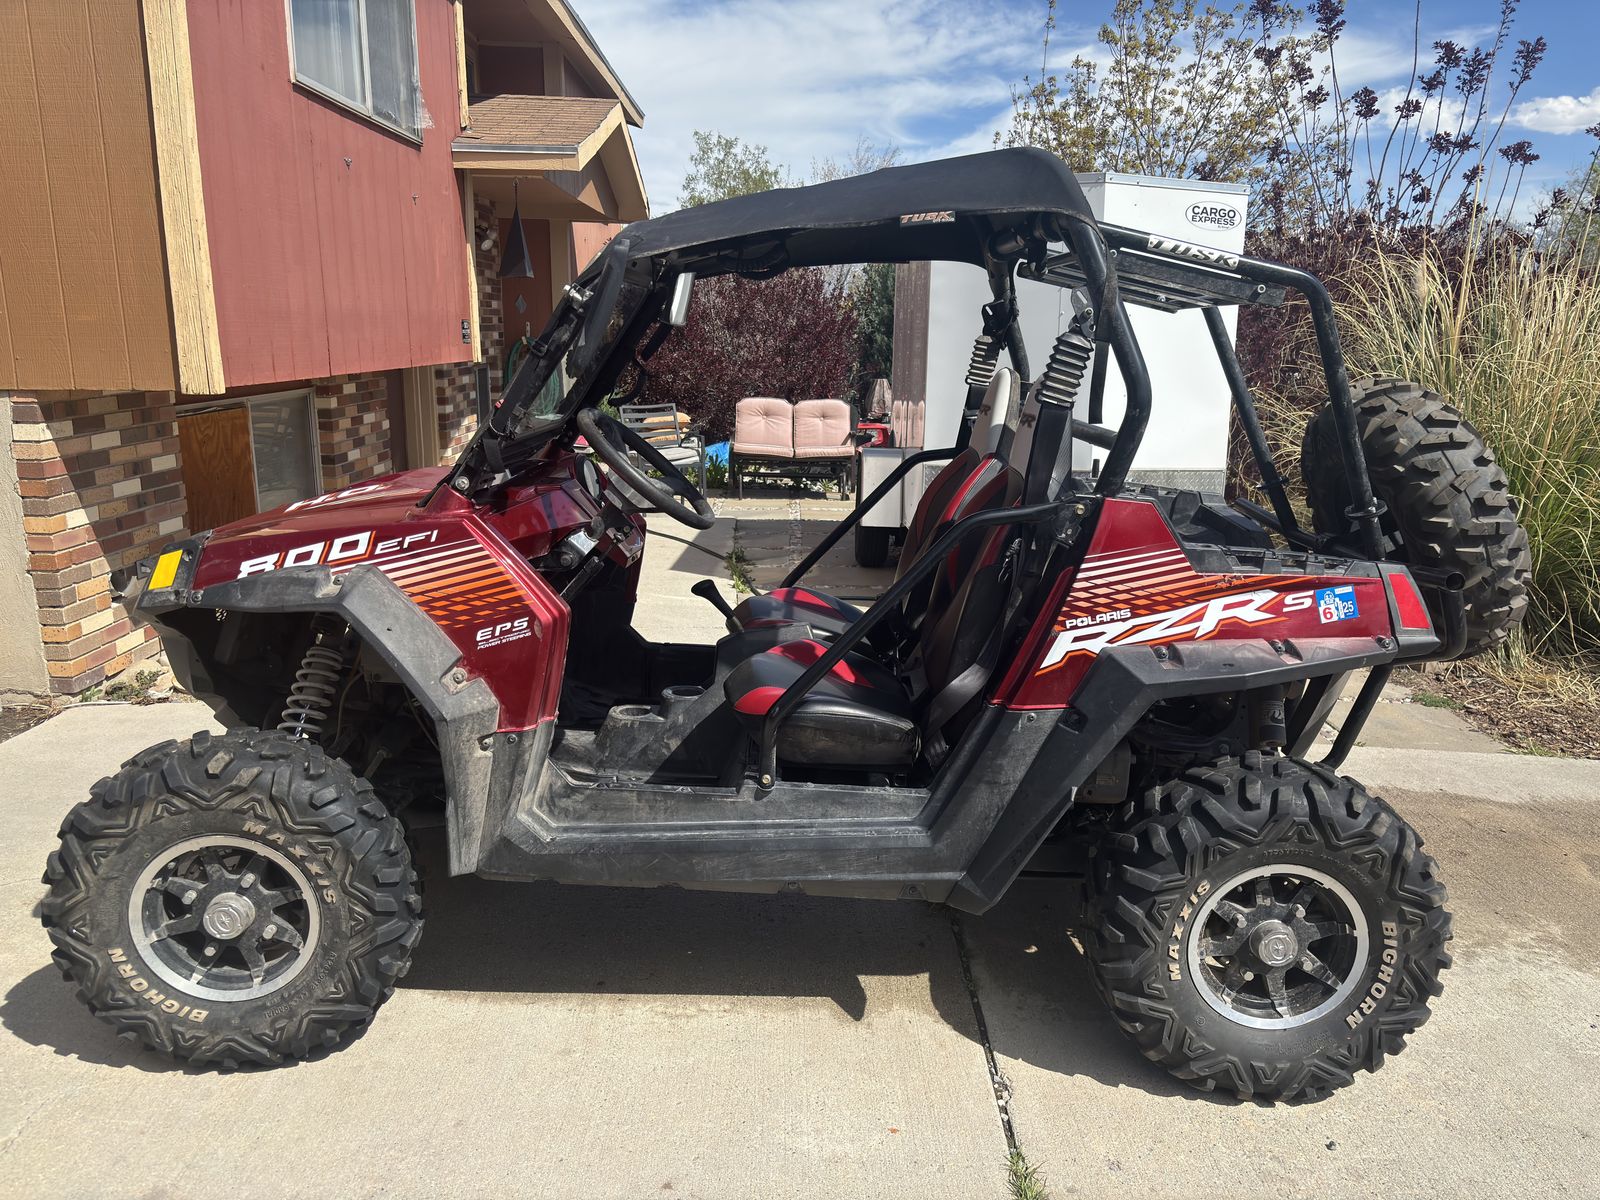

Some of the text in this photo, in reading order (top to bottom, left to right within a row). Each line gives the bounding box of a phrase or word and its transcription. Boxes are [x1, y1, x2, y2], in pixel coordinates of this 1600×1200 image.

[901, 211, 953, 223] TUSK
[1192, 206, 1236, 219] CARGO
[1192, 215, 1235, 226] EXPRESS
[1150, 238, 1236, 267] TUSK
[374, 530, 438, 555] EFI
[1065, 609, 1132, 629] POLARIS
[1322, 607, 1334, 620] 6
[1342, 601, 1354, 613] 25
[476, 617, 529, 641] EPS
[477, 632, 532, 650] POWER STEERING
[1040, 589, 1315, 669] RZR S
[242, 821, 336, 904] MAXXIS
[1168, 879, 1211, 981] MAXXIS
[107, 947, 209, 1023] BIGHORN
[1346, 921, 1398, 1029] BIGHORN
